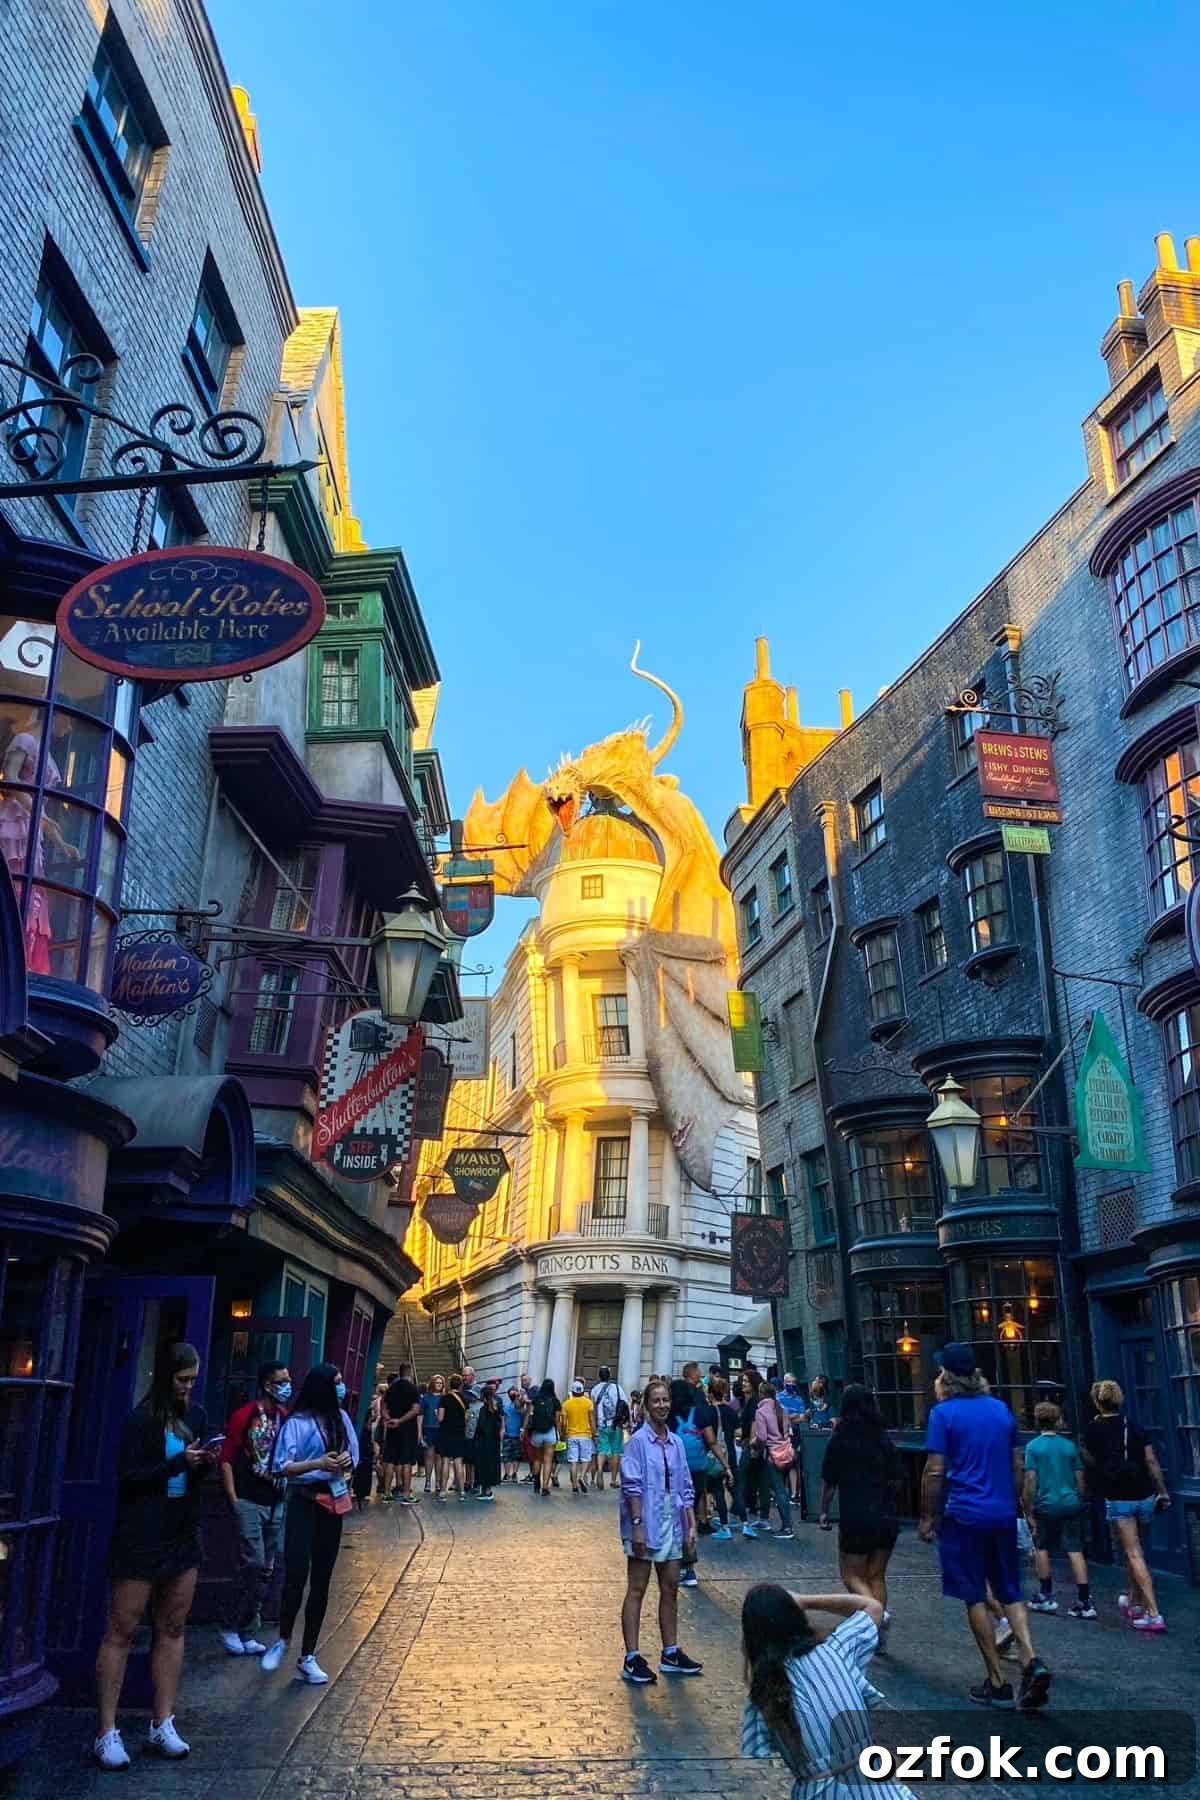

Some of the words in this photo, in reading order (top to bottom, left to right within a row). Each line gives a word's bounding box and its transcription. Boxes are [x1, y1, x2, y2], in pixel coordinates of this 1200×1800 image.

[73, 584, 201, 618] School
[199, 584, 309, 617] Robes
[104, 621, 209, 643] Available
[218, 619, 269, 640] Here
[982, 742, 1013, 757] BREWS
[1019, 746, 1049, 760] STEWS
[984, 761, 1008, 772] FISHY
[1012, 765, 1050, 776] DINNERS
[119, 947, 177, 971] Madam
[317, 1053, 416, 1146] Shutterbutton's
[349, 1140, 375, 1154] STEP
[342, 1155, 378, 1169] INSIDE
[455, 1152, 501, 1166] WAND
[454, 1167, 500, 1177] SHOWROOM
[539, 1254, 621, 1273] GRINGOTTS
[631, 1255, 670, 1273] BANK
